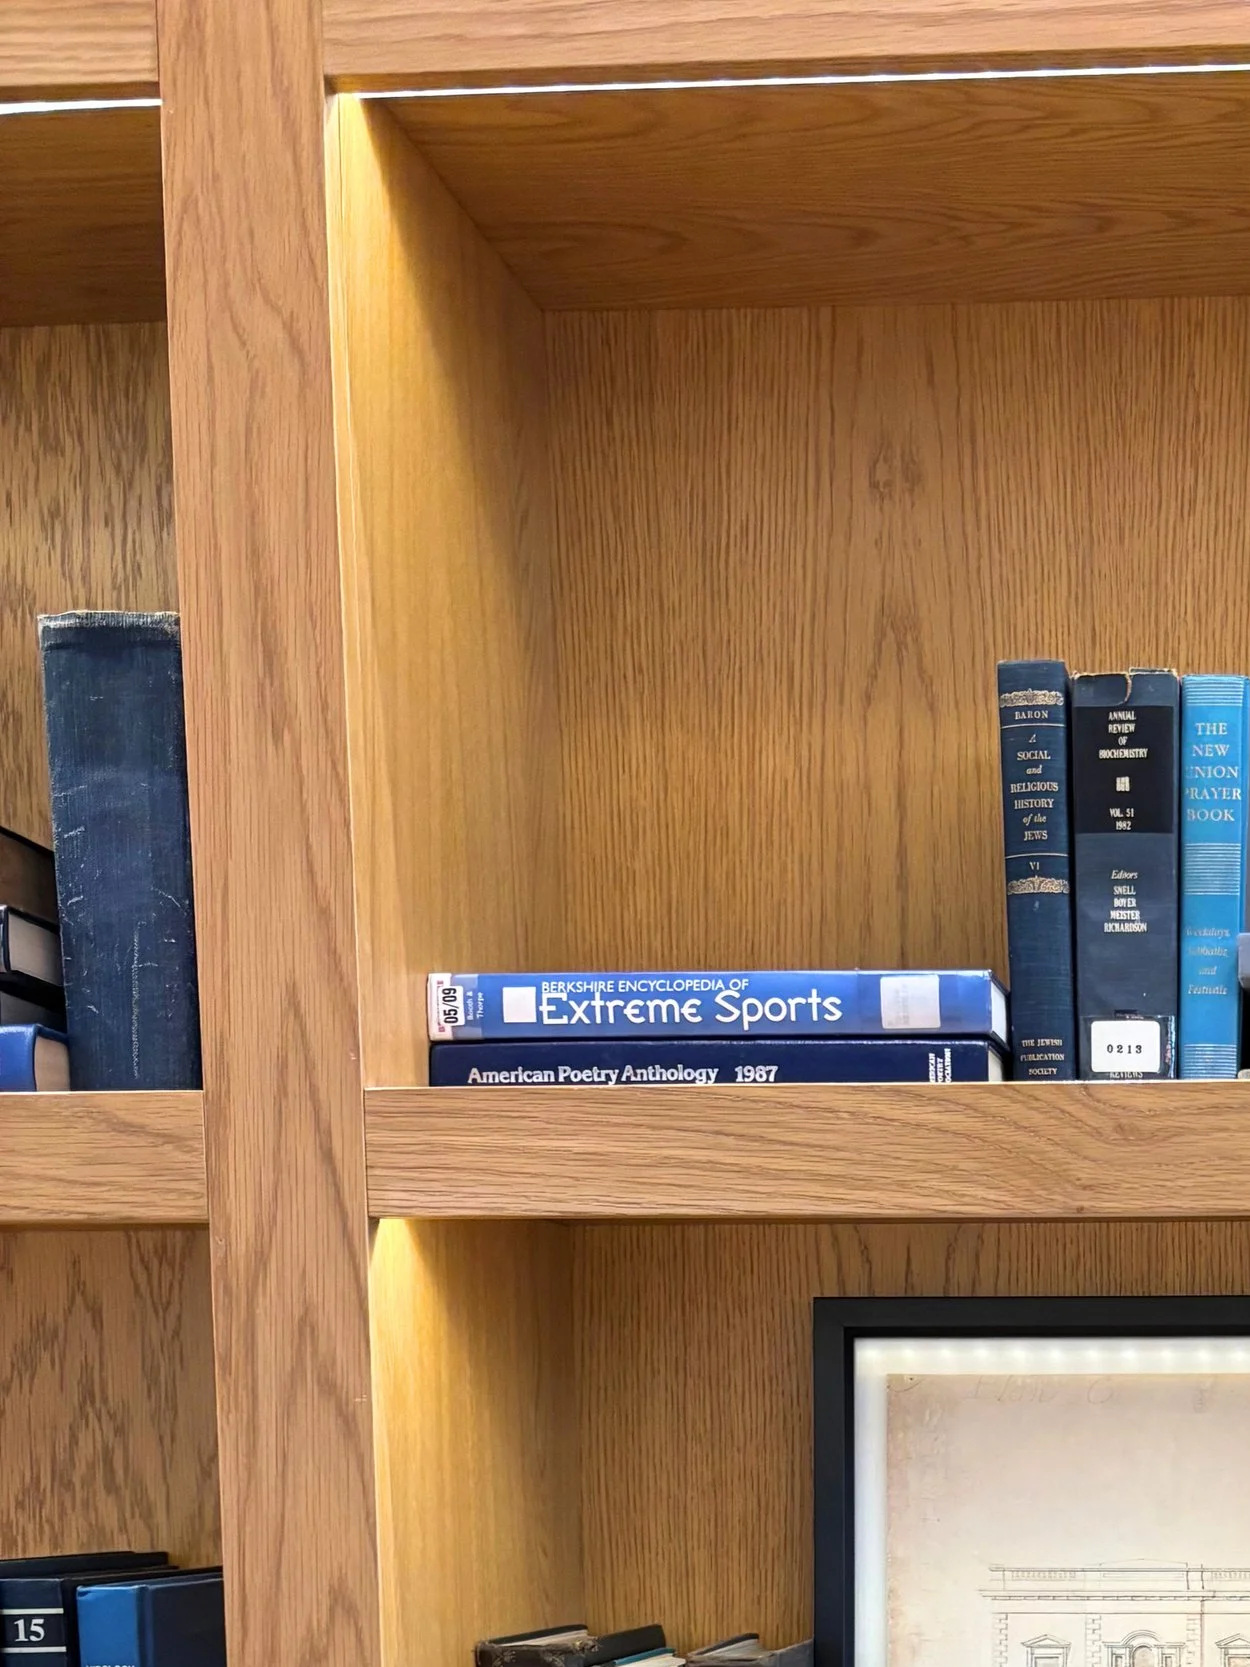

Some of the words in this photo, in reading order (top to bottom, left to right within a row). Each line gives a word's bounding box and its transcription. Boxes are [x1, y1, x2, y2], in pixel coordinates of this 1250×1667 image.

[1017, 750, 1051, 761] SOCIAL
[1011, 782, 1059, 793] RELIGIOUS
[1024, 830, 1048, 840] JEWS
[541, 980, 615, 995] BERKSHIRE
[618, 978, 727, 995] ENCYCLOPEDIA
[728, 978, 750, 993] OF
[444, 985, 458, 1024] 05/09
[540, 991, 702, 1027] Extreme
[714, 987, 843, 1031] Sports
[1106, 1043, 1143, 1055] 0213
[468, 1066, 555, 1083] American
[558, 1066, 619, 1084] Poetry
[620, 1066, 719, 1084] Anthology
[735, 1066, 778, 1083] 1987
[14, 1618, 45, 1642] 15
